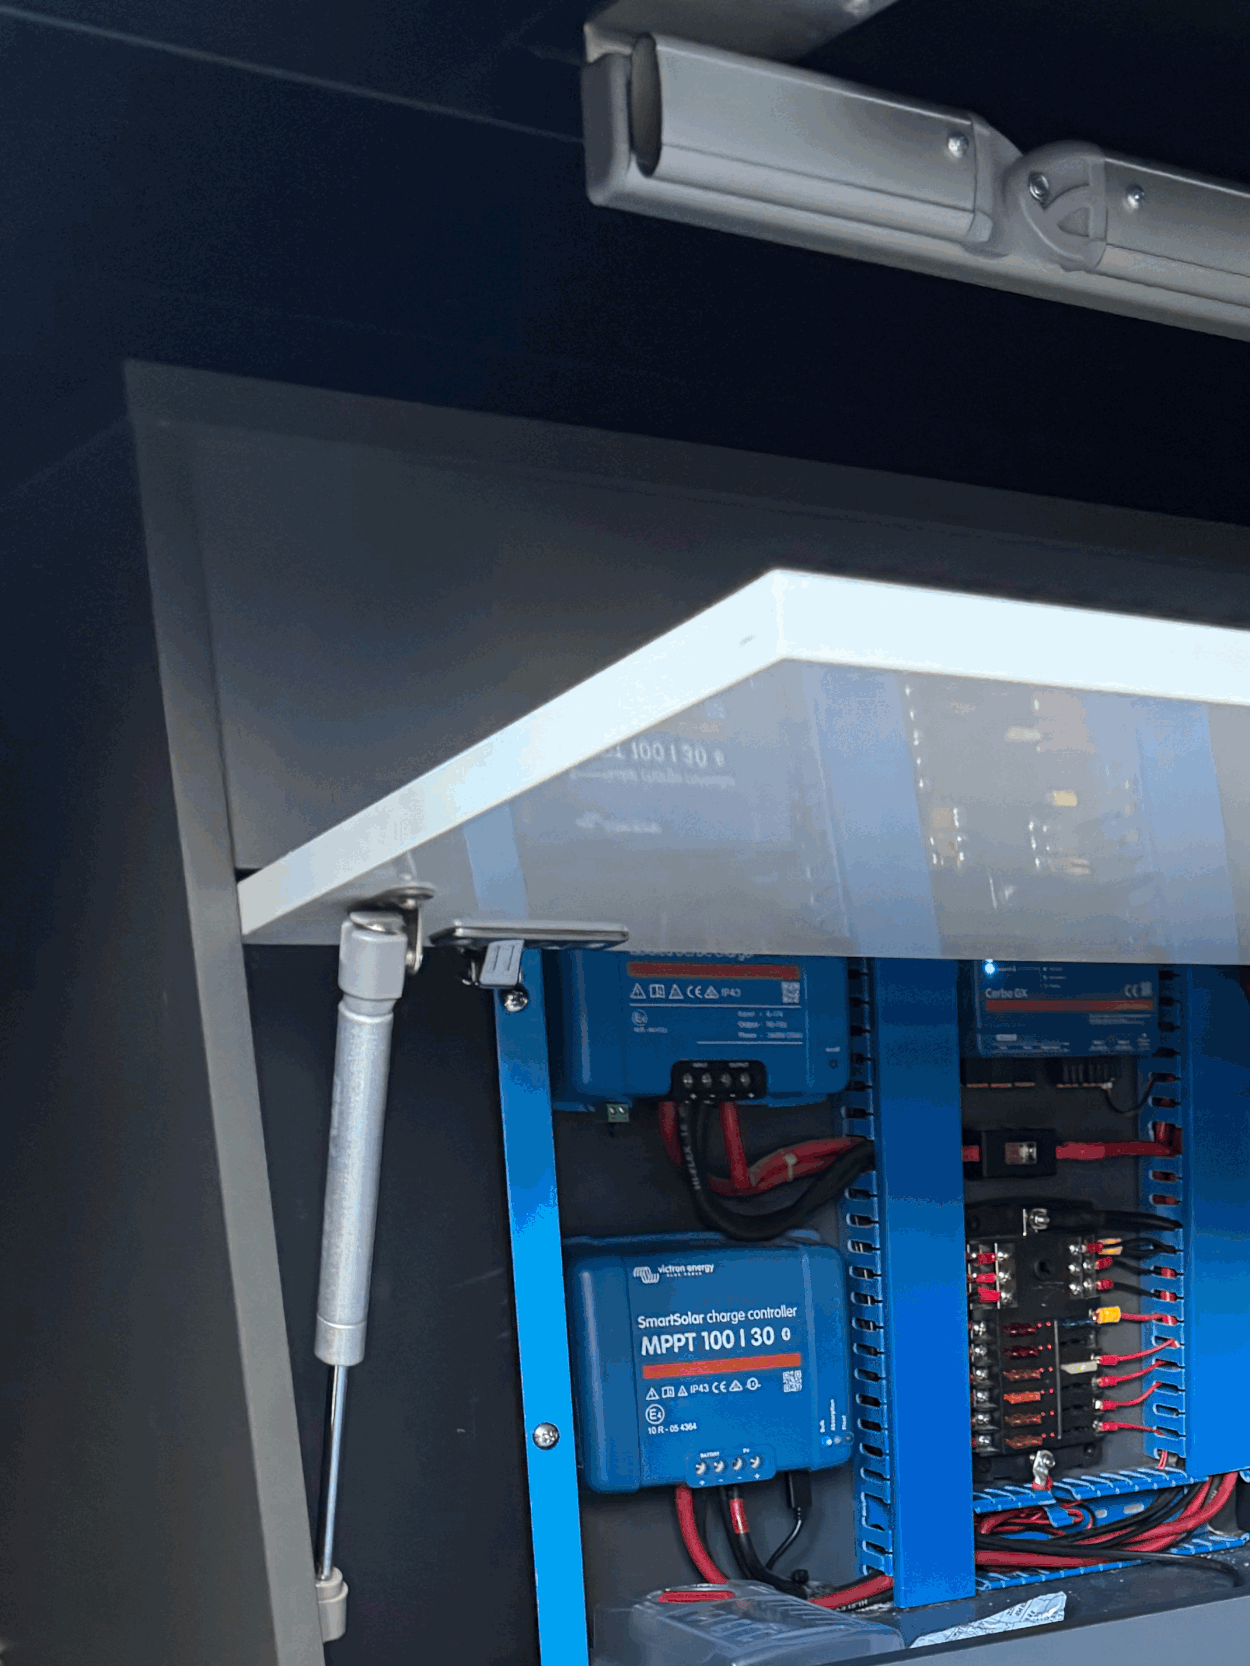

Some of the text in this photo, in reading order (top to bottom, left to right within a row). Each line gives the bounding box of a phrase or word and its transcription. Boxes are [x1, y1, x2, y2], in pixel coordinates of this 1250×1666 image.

[657, 1263, 714, 1273] victron energy
[637, 1304, 798, 1329] SmartSolar charge controller
[641, 1331, 697, 1356] MPPT
[701, 1329, 735, 1351] 100
[750, 1326, 775, 1347] 30
[690, 1383, 710, 1394] IP43
